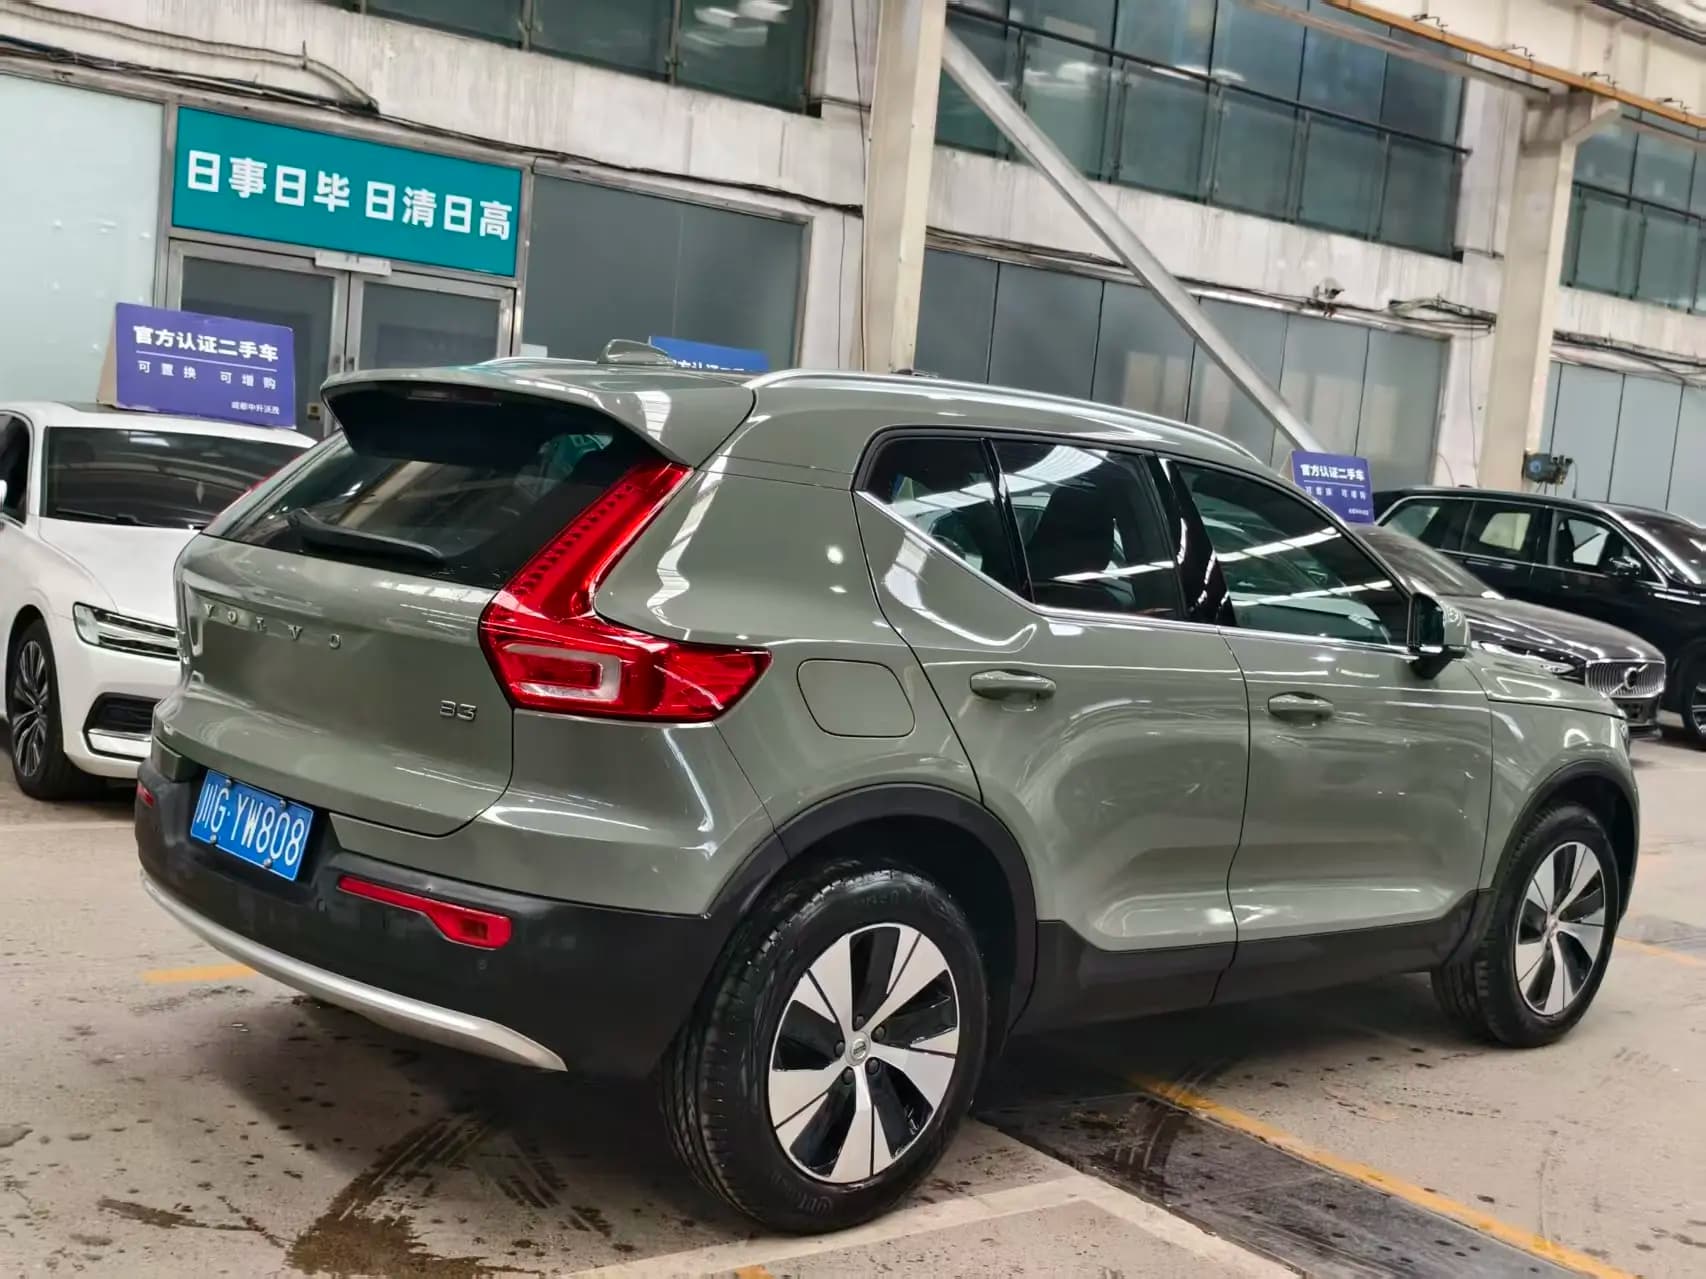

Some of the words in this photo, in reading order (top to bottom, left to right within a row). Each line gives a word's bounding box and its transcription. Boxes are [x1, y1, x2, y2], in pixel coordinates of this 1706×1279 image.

[187, 149, 350, 212] 日事日毕
[365, 181, 513, 241] 日清日高
[133, 325, 279, 362] 官方认证二手车
[204, 603, 341, 649] VOLVO
